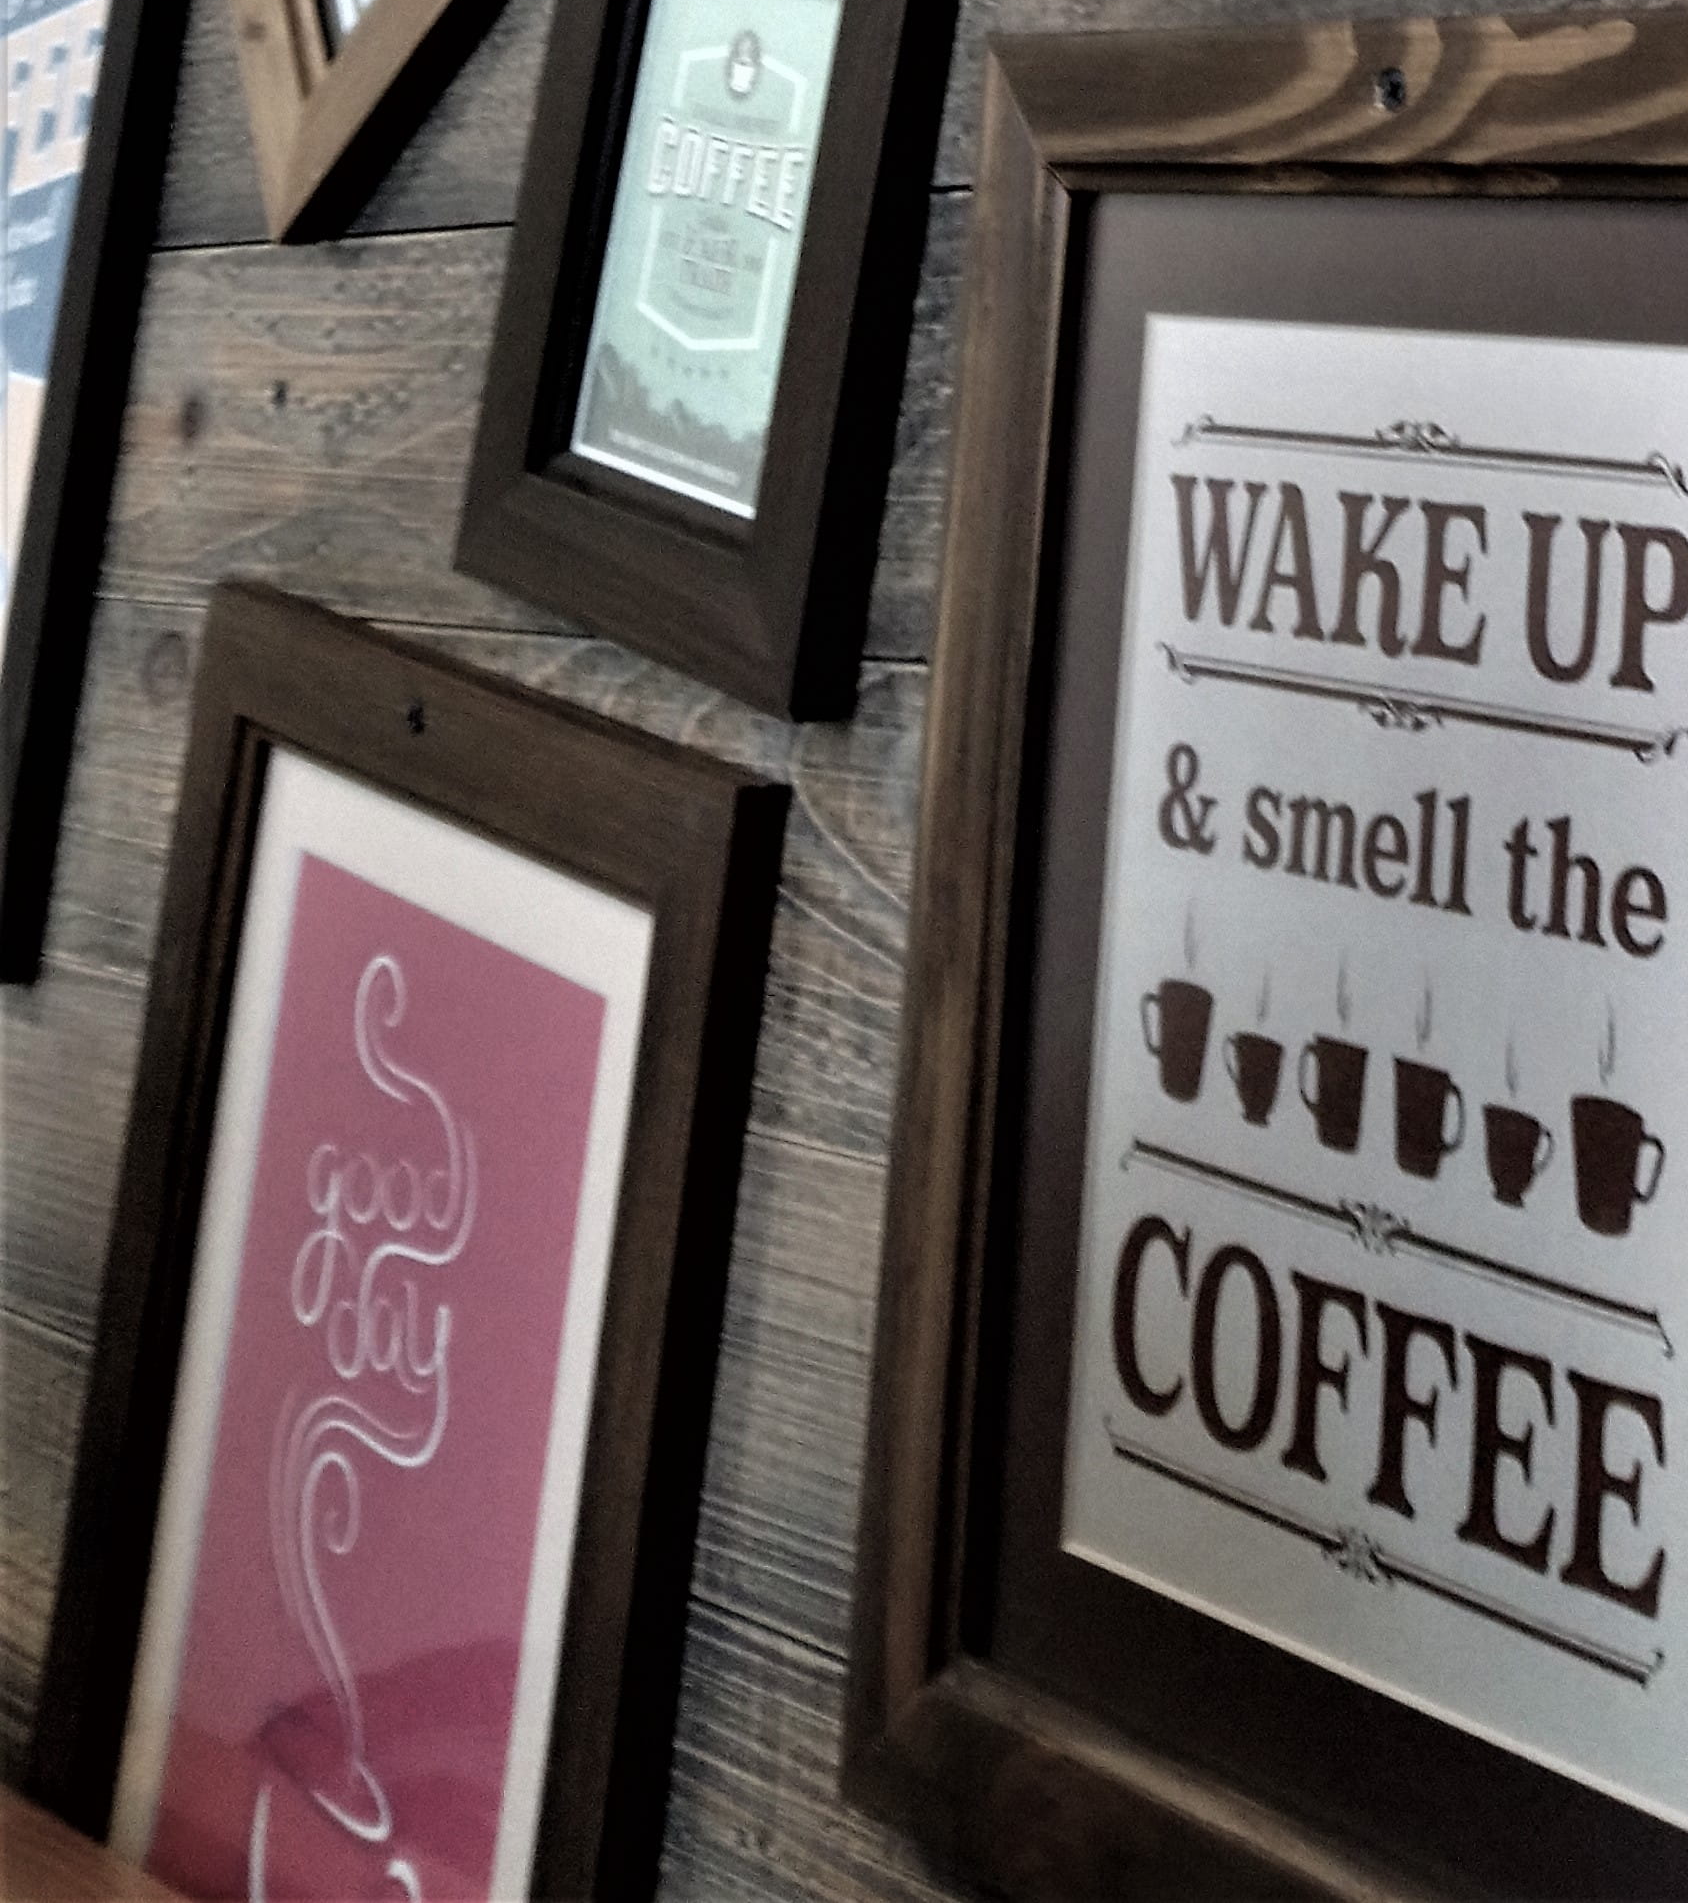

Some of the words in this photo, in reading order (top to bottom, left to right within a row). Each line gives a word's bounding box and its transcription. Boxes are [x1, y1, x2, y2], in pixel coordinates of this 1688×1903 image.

[647, 114, 806, 233] COFFEE
[1168, 472, 1489, 667] WAKE
[1156, 740, 1220, 856] &
[1241, 783, 1474, 918] smell
[1503, 812, 1671, 961] the
[1110, 1213, 1668, 1621] COFFEE
